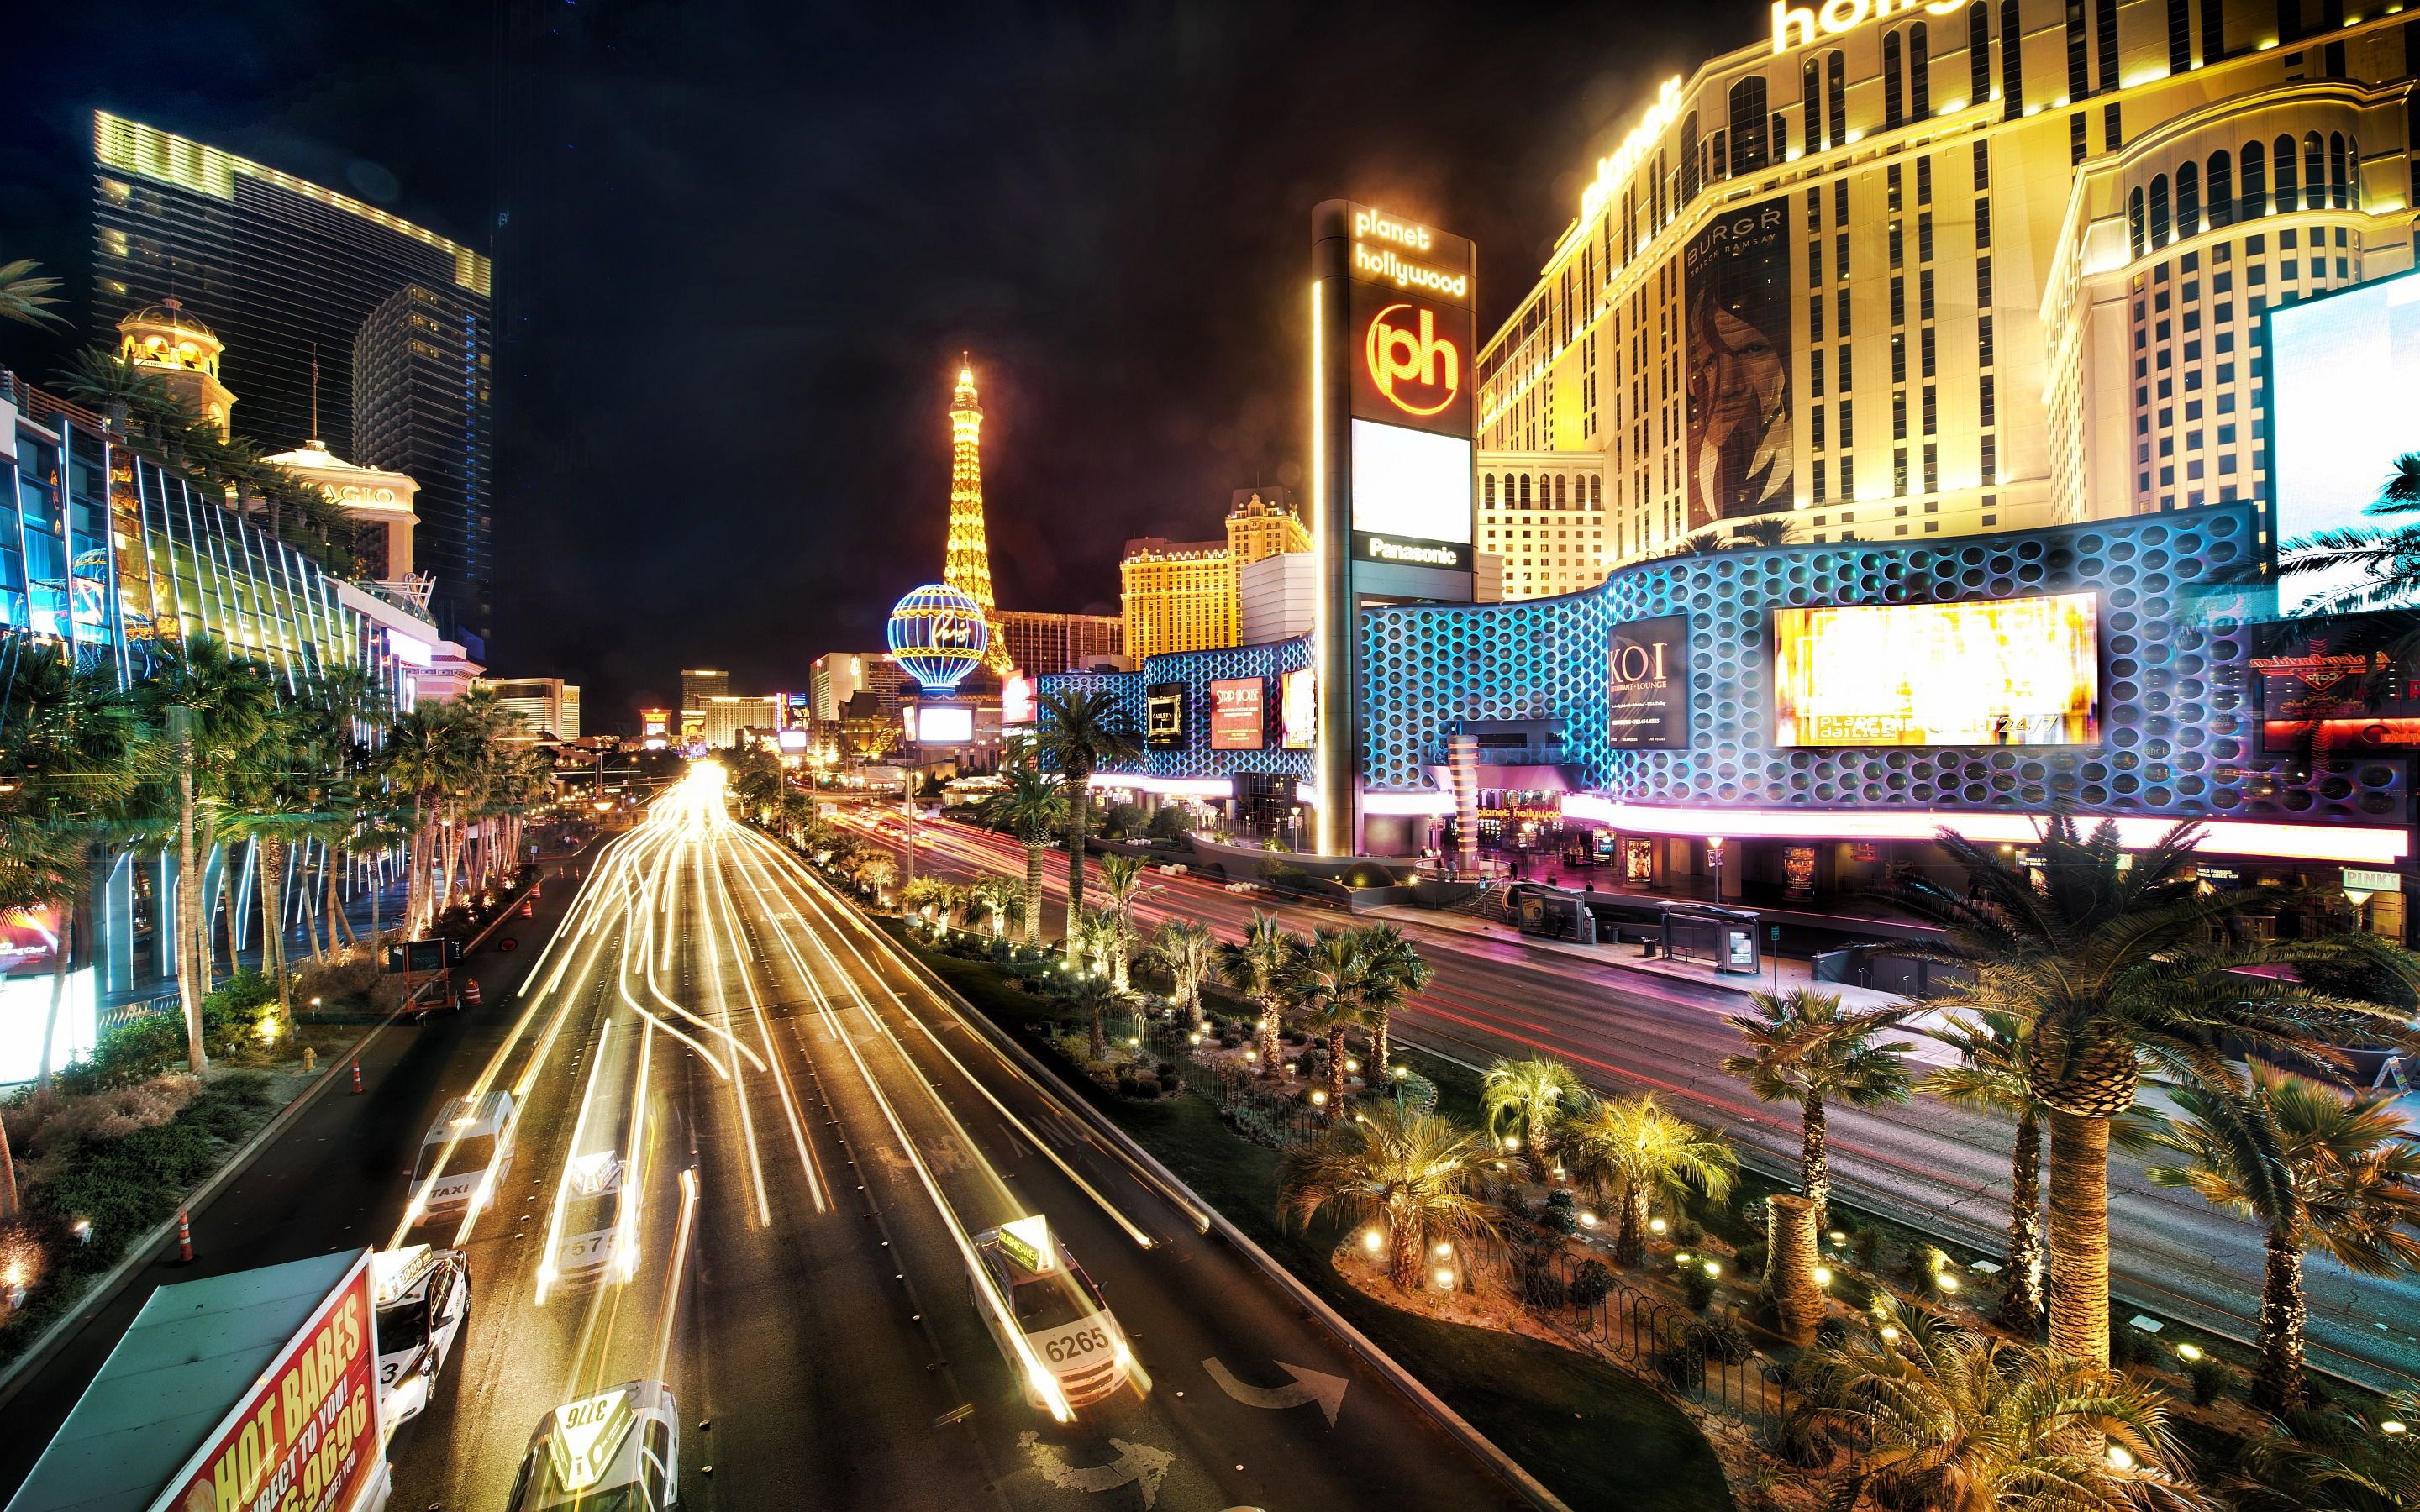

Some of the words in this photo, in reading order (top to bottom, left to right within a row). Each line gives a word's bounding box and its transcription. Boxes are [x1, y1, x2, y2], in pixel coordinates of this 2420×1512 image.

[1355, 209, 1430, 250] planet
[1687, 210, 1781, 268] BURGR
[1356, 242, 1466, 296] hollywood
[1690, 251, 1718, 278] GORDON
[1724, 233, 1777, 253] RAMSAY
[1378, 307, 1459, 396] ph
[322, 484, 395, 505] AGIO
[1370, 538, 1457, 565] Panasonic
[931, 610, 972, 651] Paris
[1610, 643, 1667, 684] KOI
[1216, 690, 1235, 705] STRIP
[1235, 688, 1260, 705] HOUSE
[1637, 681, 1667, 690] LOUNGE
[1998, 715, 2059, 734] 24/7
[1476, 807, 1511, 818] planet
[1513, 808, 1561, 820] hollywoo
[2346, 871, 2397, 888] PINK'S
[430, 1184, 470, 1199] TAXI
[1045, 1326, 1109, 1363] 6265
[380, 1362, 399, 1384] 3
[213, 1392, 280, 1512] HOT
[281, 1294, 360, 1450] BABES
[299, 1420, 318, 1465] TO
[318, 1374, 349, 1436] YOU!
[566, 1399, 608, 1430] 3776
[324, 1470, 342, 1507] MEET
[342, 1449, 356, 1479] YOU
